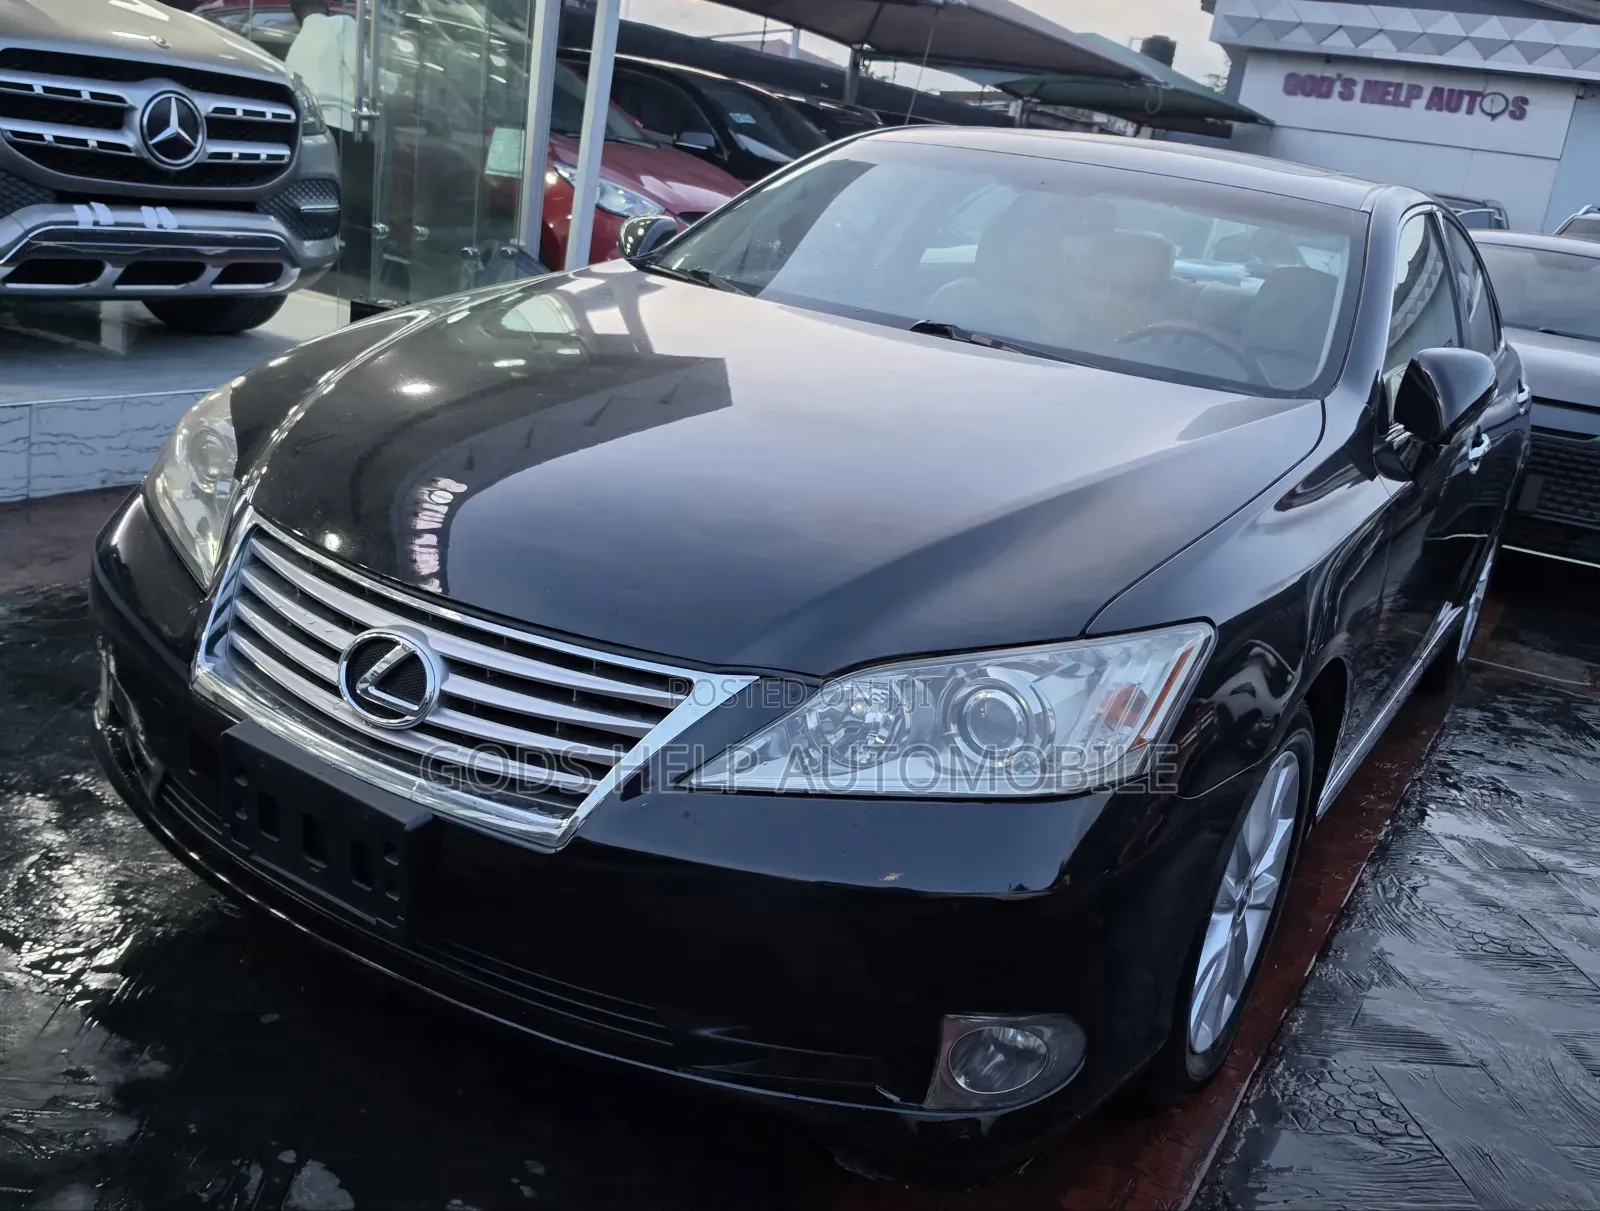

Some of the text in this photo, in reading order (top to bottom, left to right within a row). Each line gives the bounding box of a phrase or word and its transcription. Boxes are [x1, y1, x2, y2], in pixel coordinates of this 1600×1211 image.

[1282, 72, 1529, 121] GOD'S HELP AUTOS
